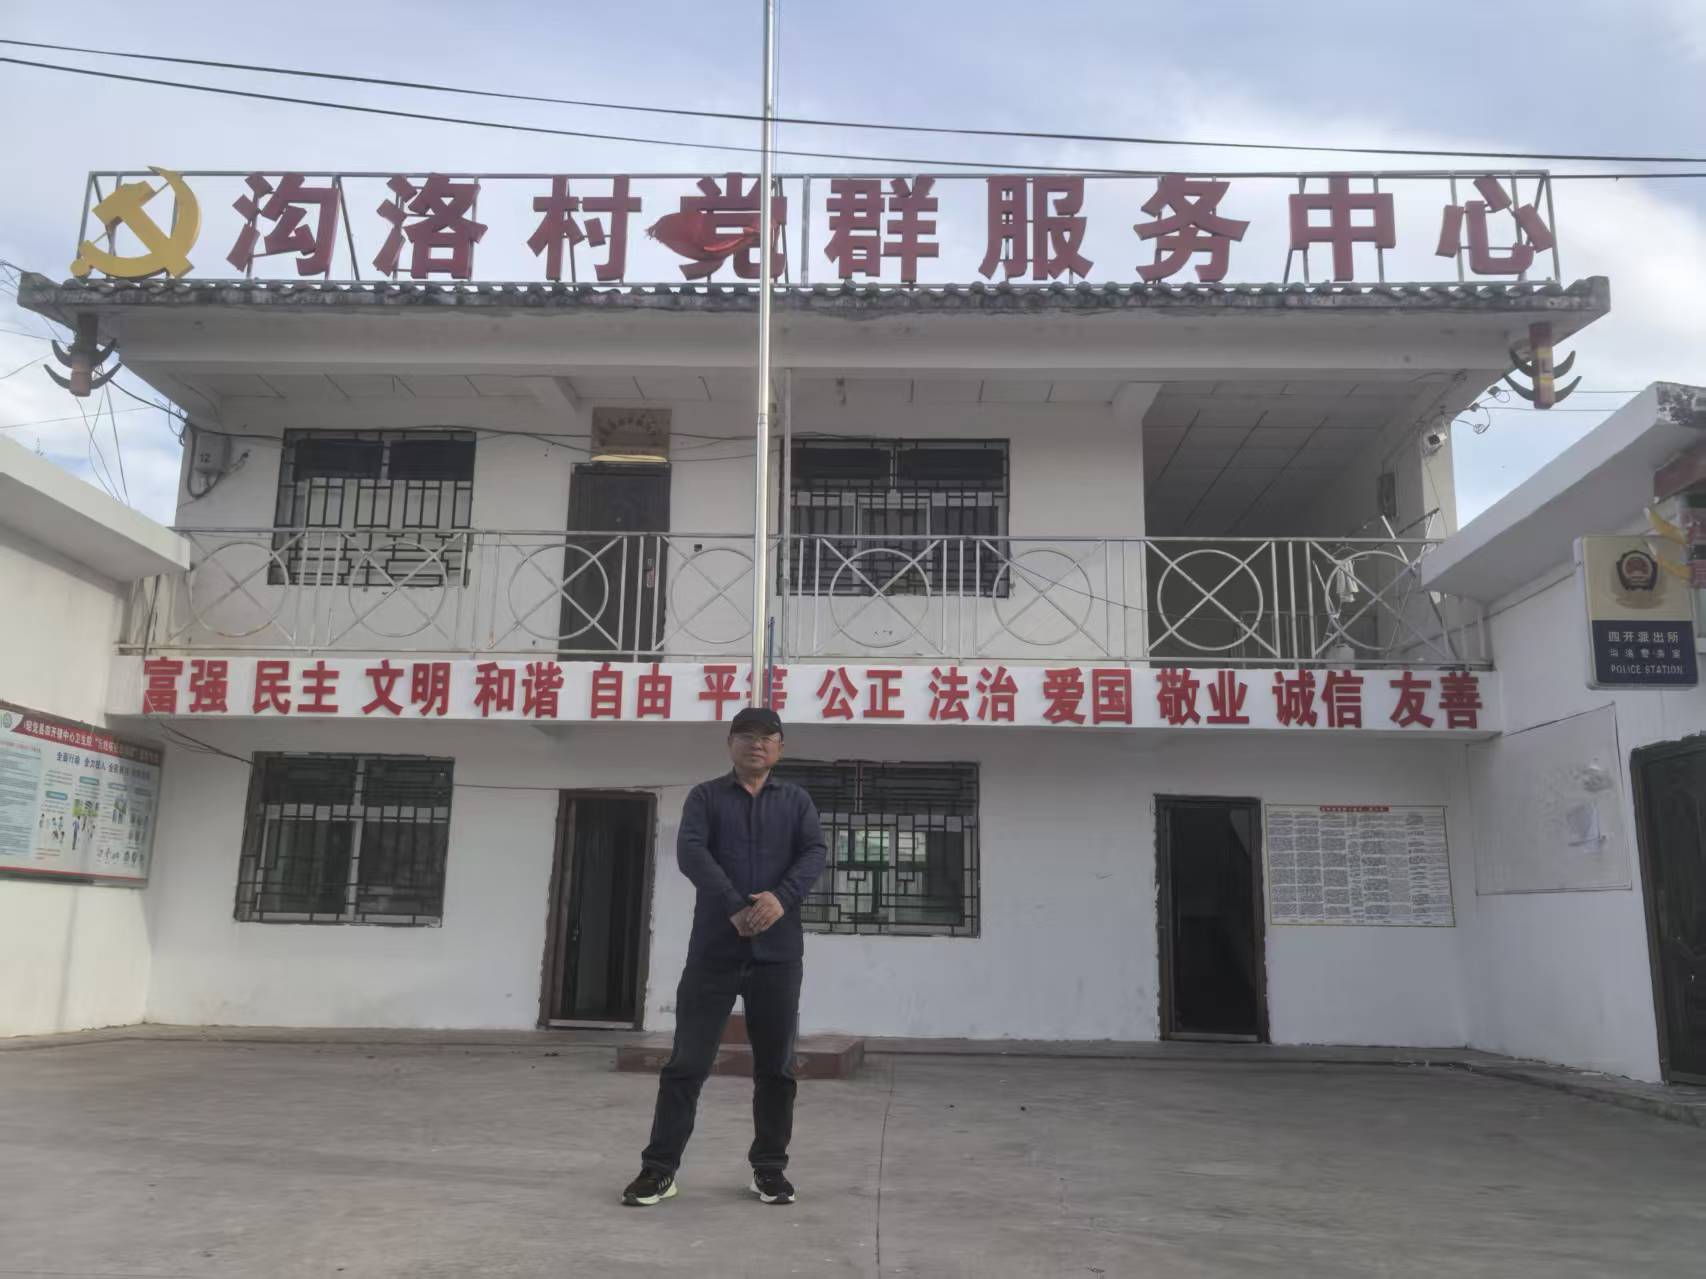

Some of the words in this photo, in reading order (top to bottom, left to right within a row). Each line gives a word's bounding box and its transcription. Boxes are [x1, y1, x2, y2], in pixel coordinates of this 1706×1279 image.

[226, 172, 1555, 282] 沟洛村党群服务中心
[1608, 631, 1679, 643] 四开派出所
[1645, 664, 1683, 675] STATION
[143, 657, 229, 714] 富强
[252, 660, 339, 714] 民主
[362, 659, 450, 717] 文明
[474, 661, 564, 719] 和谐
[590, 662, 673, 719] 自由
[816, 667, 904, 721] 公正
[928, 666, 1018, 721] 法治
[1043, 667, 1133, 725] 爱国
[1156, 667, 1249, 725] 敬业
[1272, 670, 1364, 728] 诚信
[1389, 671, 1483, 729] 友善
